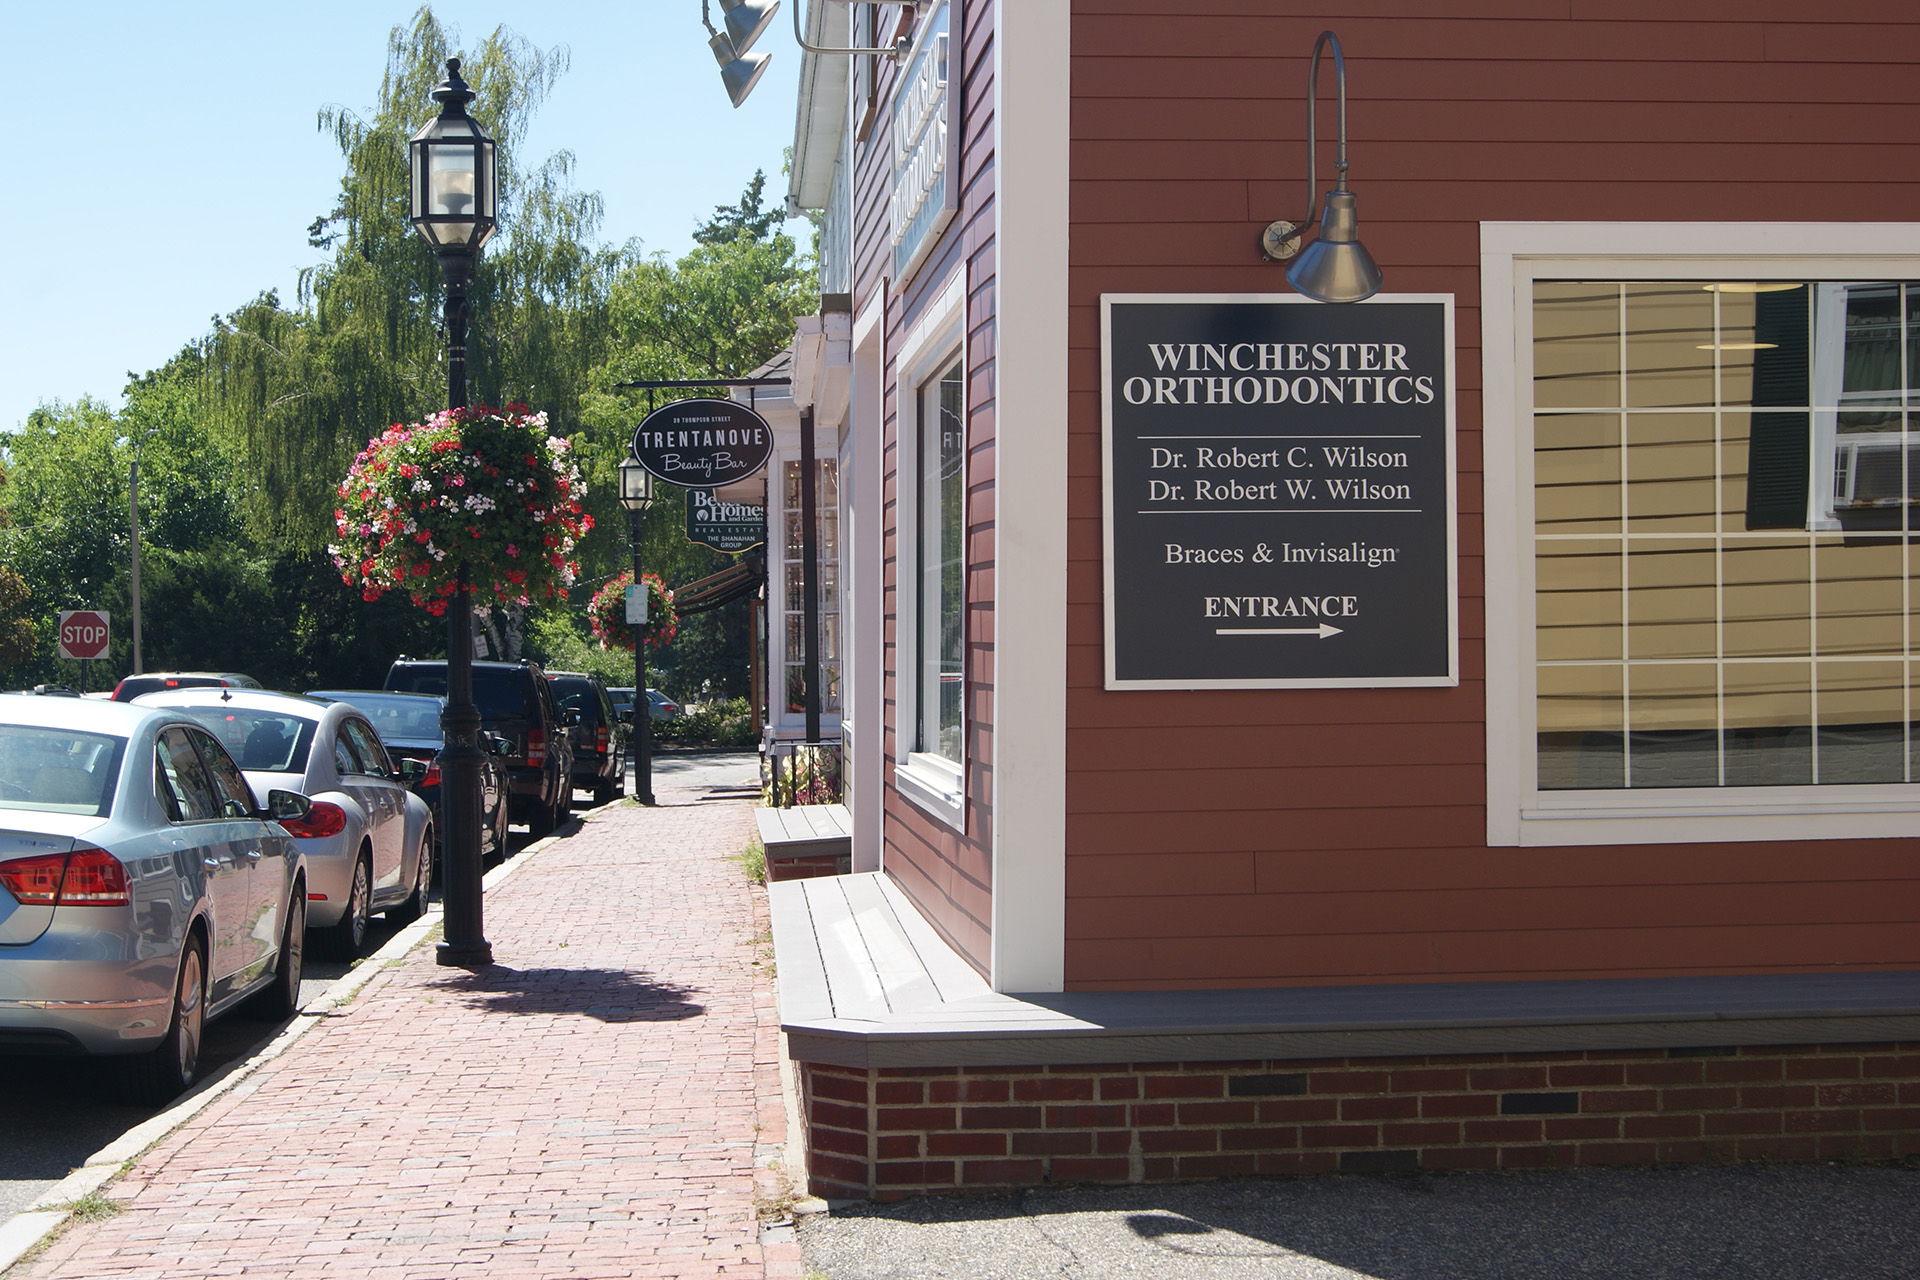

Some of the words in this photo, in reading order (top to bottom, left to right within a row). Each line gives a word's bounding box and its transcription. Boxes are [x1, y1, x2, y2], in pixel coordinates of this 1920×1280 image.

[1148, 343, 1410, 371] WINCHESTER
[1123, 376, 1435, 405] ORTHODONTICS
[711, 415, 731, 423] STREET
[642, 428, 763, 449] TRENTANOVE
[660, 453, 712, 478] Beauty
[711, 451, 748, 470] Bar
[1151, 447, 1187, 469] Dr.
[1197, 446, 1280, 468] Robert
[1287, 446, 1314, 468] C.
[1323, 446, 1408, 468] Wilson
[1149, 480, 1185, 501] Dr.
[1195, 479, 1277, 501] Robert
[1285, 479, 1316, 500] W.
[1326, 479, 1411, 500] Wilson
[1165, 543, 1244, 564] Braces
[1252, 542, 1274, 563] &
[1204, 595, 1359, 618] ENTRANCE
[63, 625, 106, 644] STOP
